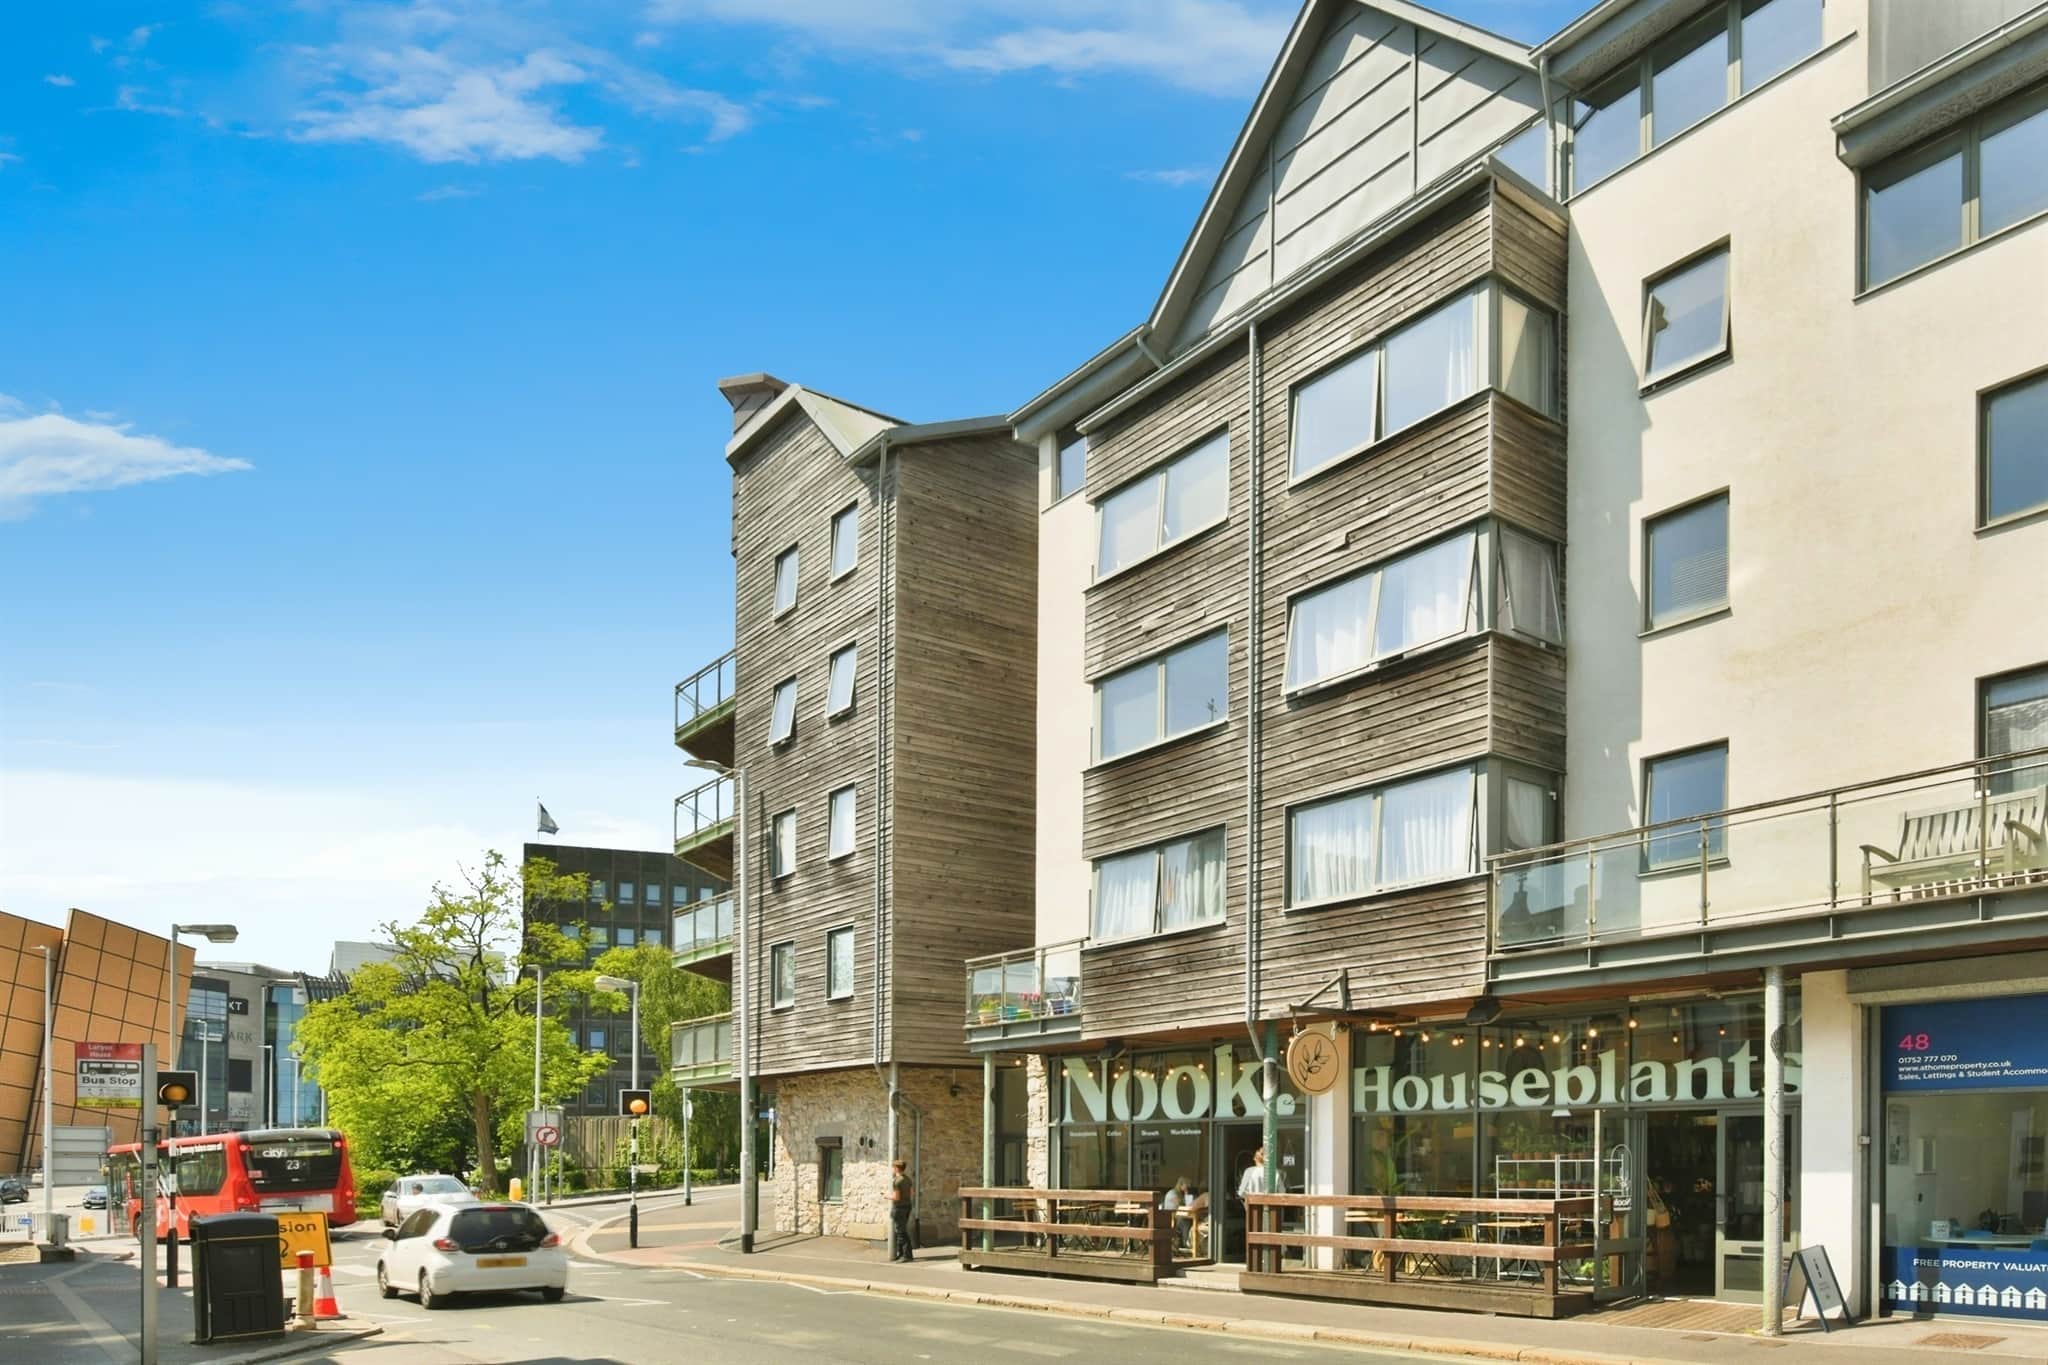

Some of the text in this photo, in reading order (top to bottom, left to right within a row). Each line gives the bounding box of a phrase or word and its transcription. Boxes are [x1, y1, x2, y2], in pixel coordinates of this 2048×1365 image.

[1899, 1033, 1929, 1050] 48
[1898, 1054, 1958, 1064] 01752 777 070
[1898, 1060, 2012, 1072] www.athomeproperty.co.uk
[1898, 1067, 2048, 1080] Sales, Lettings & Student Accommo
[81, 1076, 137, 1086] Bus Stop
[286, 1160, 300, 1170] 23
[1913, 1258, 2048, 1272] FREE PROPERTY VALUAT
